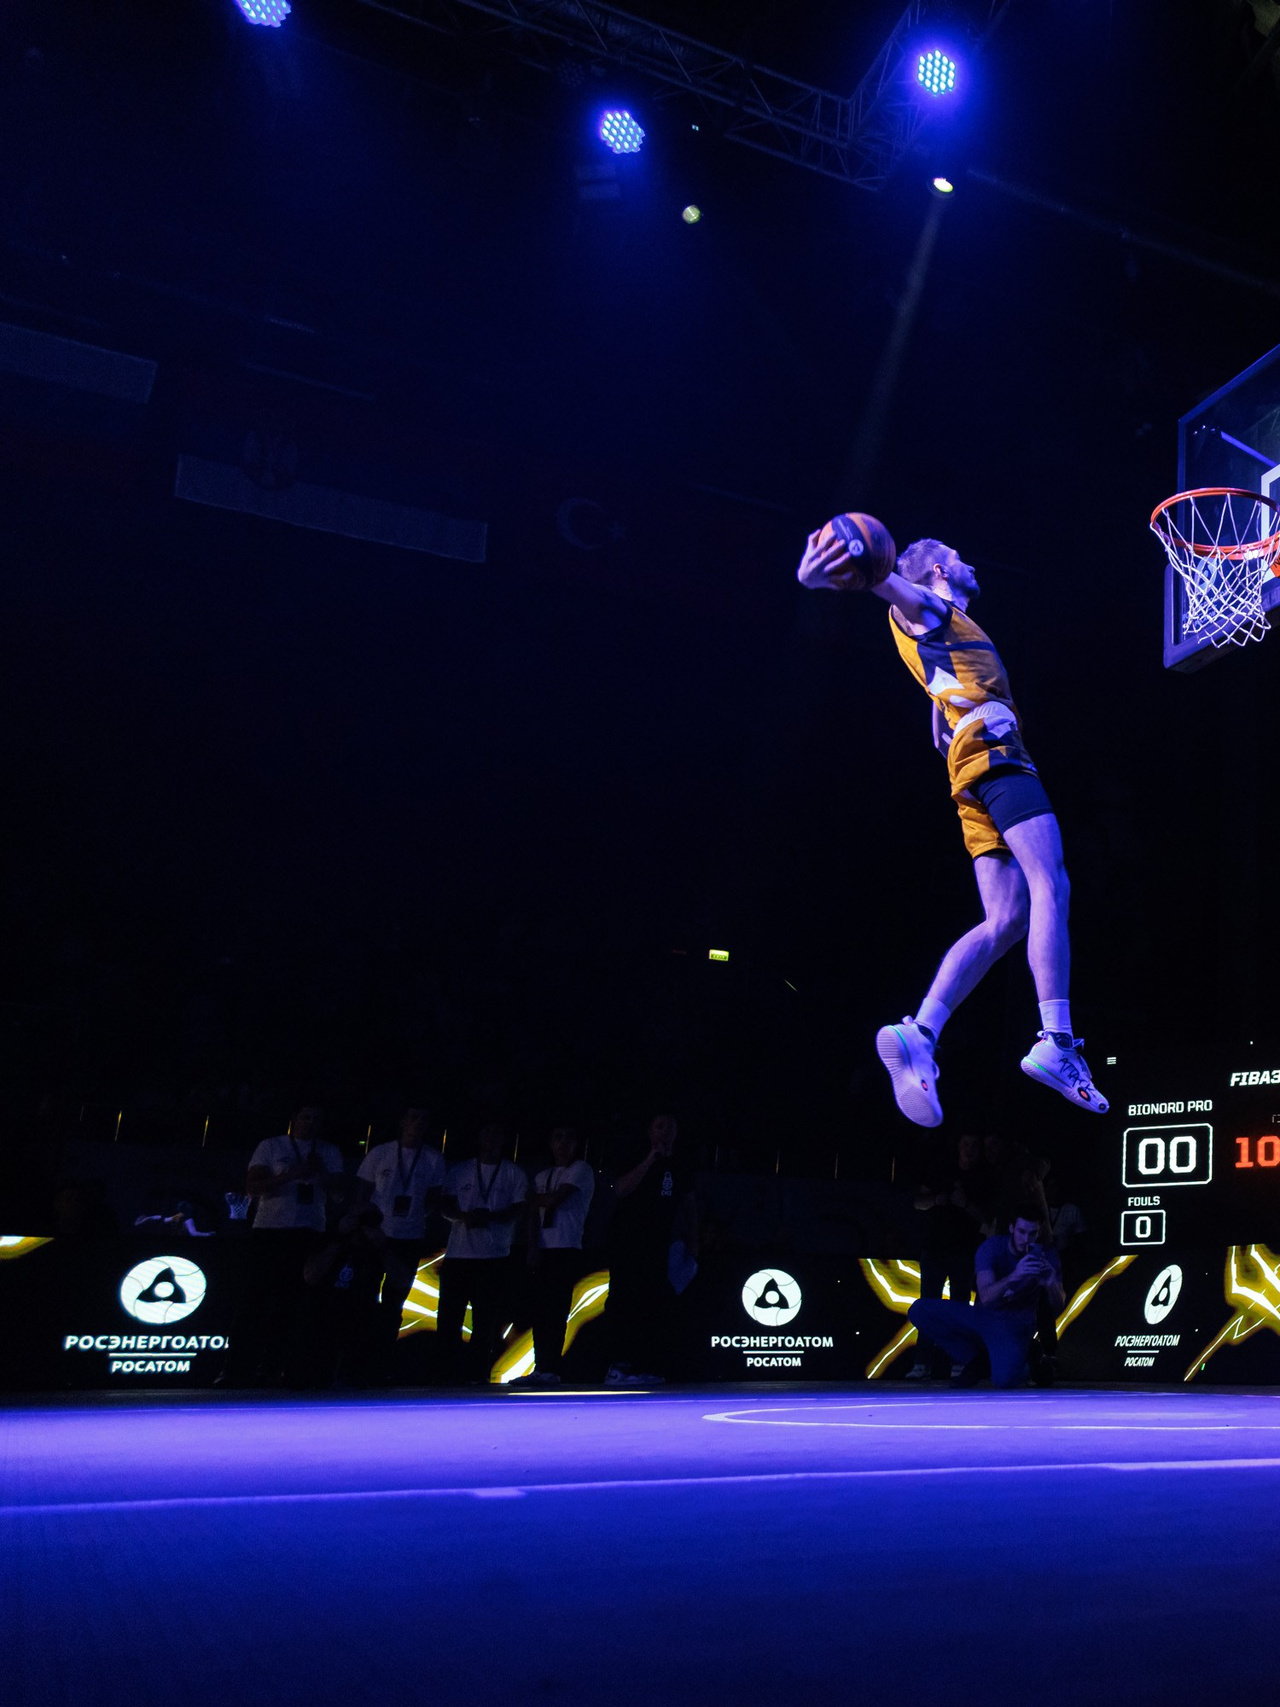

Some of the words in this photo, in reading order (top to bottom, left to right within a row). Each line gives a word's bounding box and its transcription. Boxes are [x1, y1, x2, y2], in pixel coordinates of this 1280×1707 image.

[1127, 1101, 1185, 1117] BIONORD
[1187, 1099, 1213, 1113] PRO
[1137, 1135, 1198, 1176] 00
[1127, 1195, 1161, 1207] FOULS
[1135, 1215, 1152, 1239] 0
[64, 1335, 229, 1350] РОСЭНЕРГОАТО
[710, 1335, 834, 1348] РОСЭНЕРГОАТОМ
[1114, 1334, 1181, 1347] РОСЭНЕРГОАТОМ
[110, 1360, 191, 1373] РОСАТОМ
[746, 1356, 802, 1368] РОСАТОМ
[1123, 1356, 1155, 1367] РОСАТОМ
